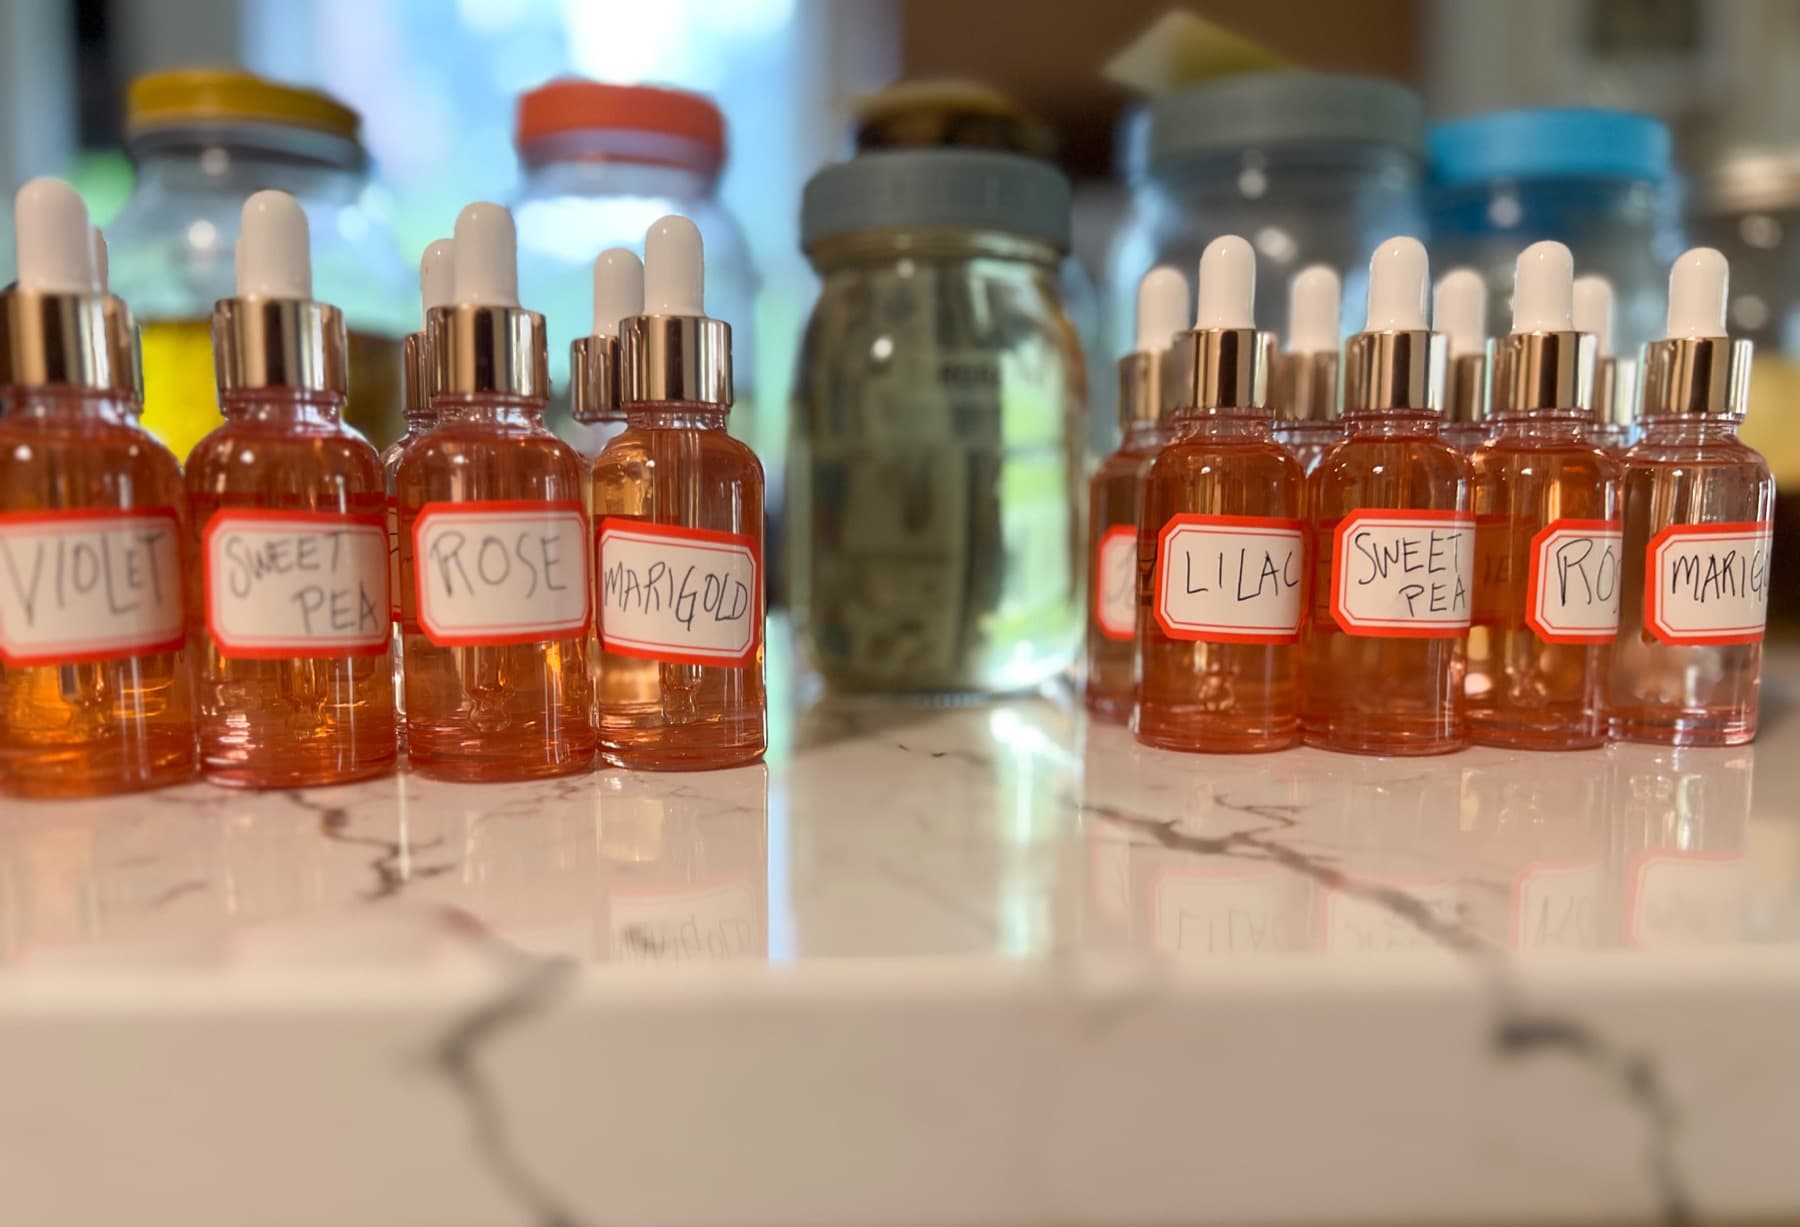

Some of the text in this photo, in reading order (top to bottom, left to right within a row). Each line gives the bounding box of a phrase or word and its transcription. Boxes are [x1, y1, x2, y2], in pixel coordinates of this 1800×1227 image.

[1, 530, 167, 628] VIOLET
[225, 533, 349, 600] SWEET
[431, 529, 568, 600] ROSE
[1186, 547, 1299, 602] LILAC
[1354, 530, 1463, 586] SWEET
[291, 580, 380, 635] PEA
[604, 560, 749, 633] MARIGOLD
[1398, 576, 1467, 618] PEA
